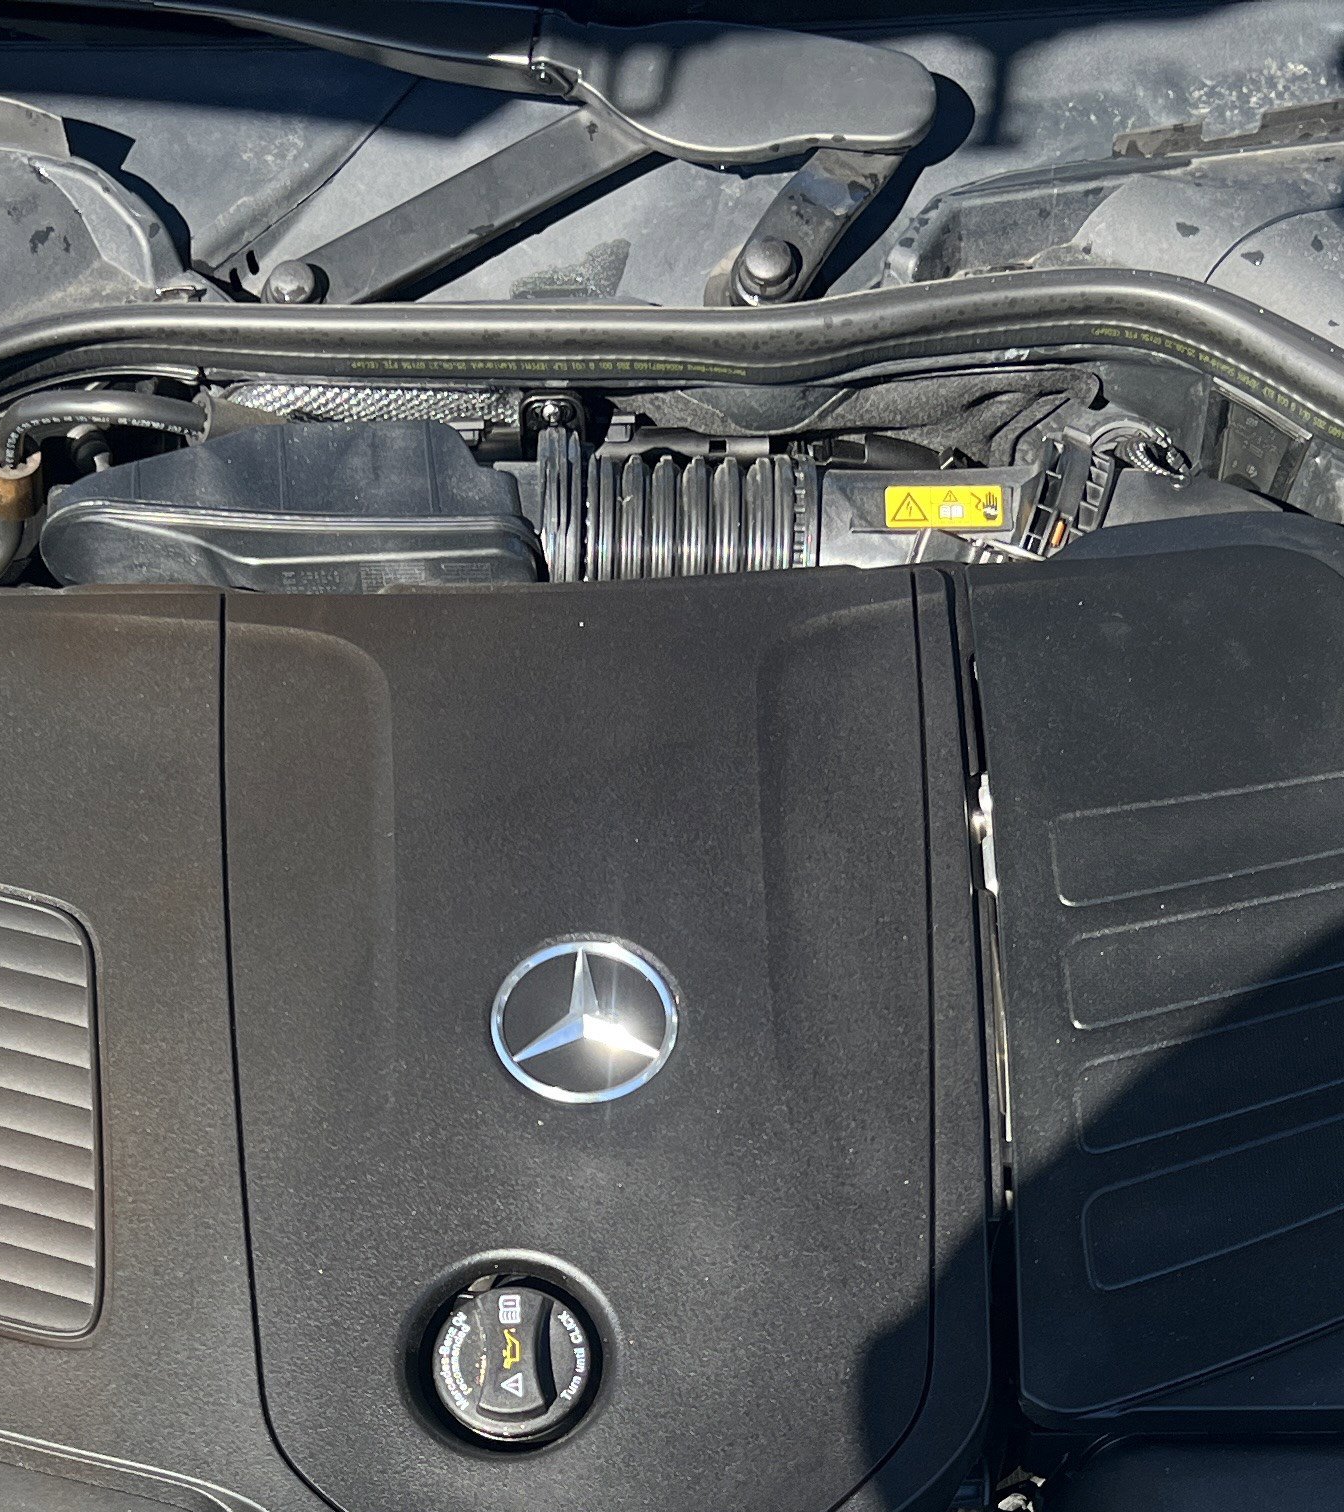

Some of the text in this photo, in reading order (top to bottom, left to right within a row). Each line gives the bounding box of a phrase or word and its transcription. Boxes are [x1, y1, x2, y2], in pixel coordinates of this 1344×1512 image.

[438, 1326, 470, 1411] Mercedes-Benz
[450, 1323, 473, 1396] recommended
[557, 1310, 586, 1401] Turn until CLICK
